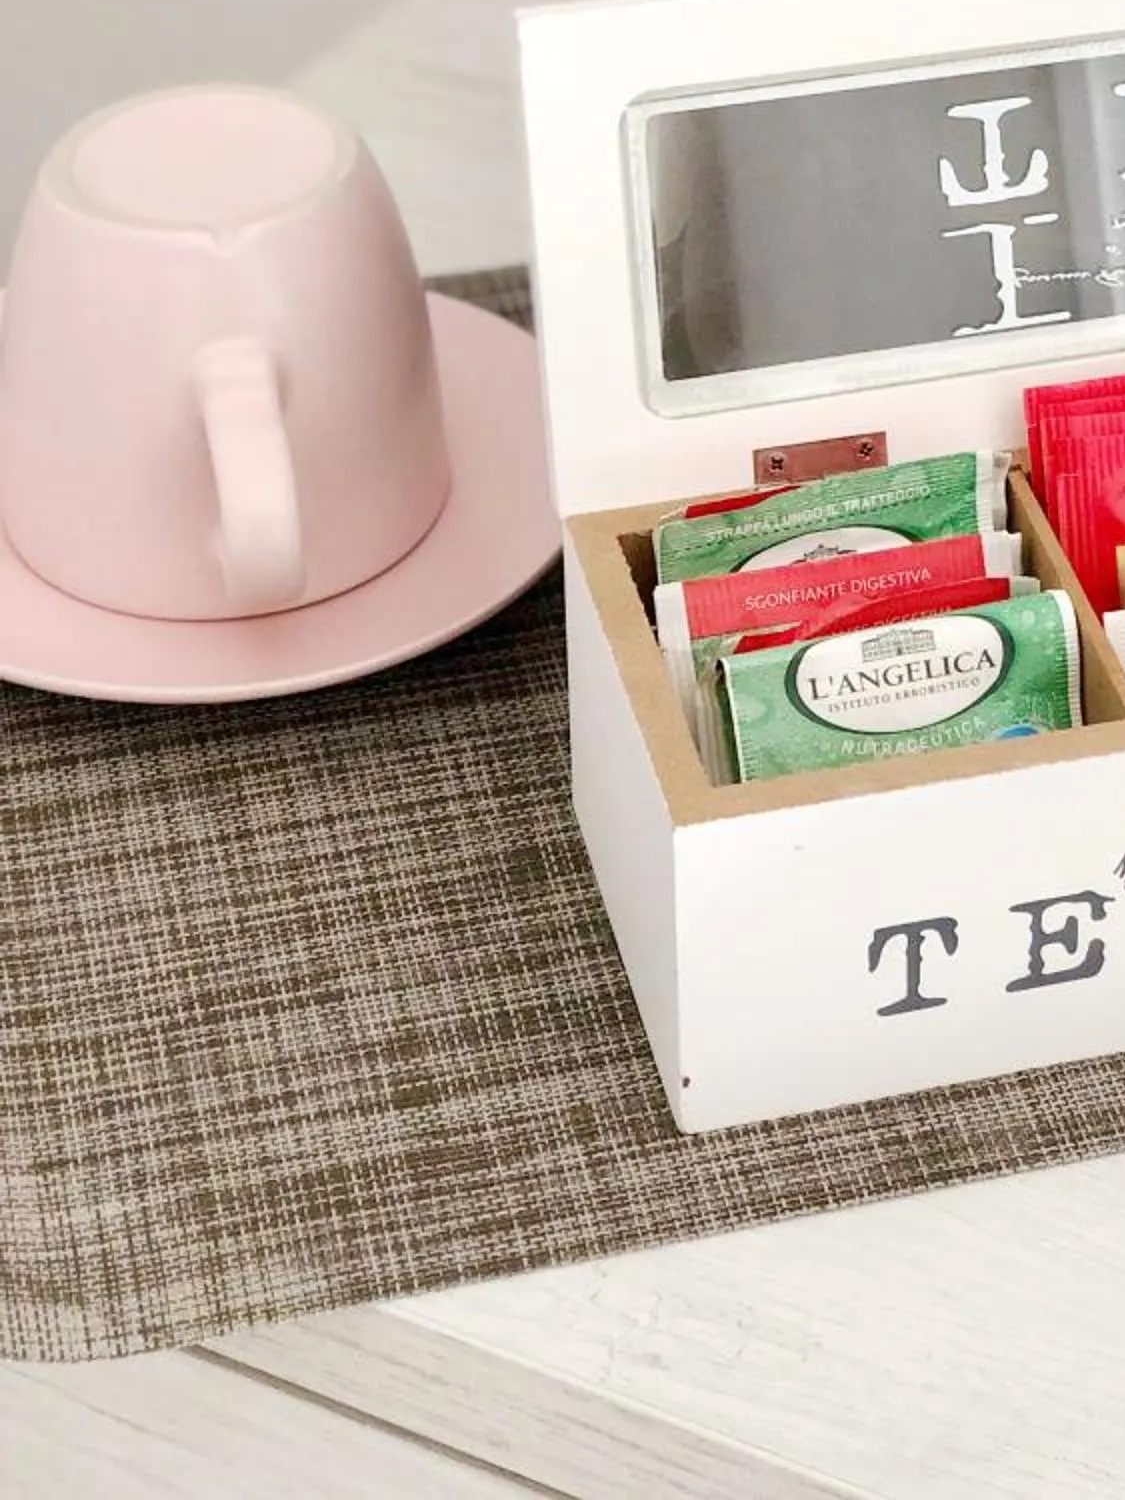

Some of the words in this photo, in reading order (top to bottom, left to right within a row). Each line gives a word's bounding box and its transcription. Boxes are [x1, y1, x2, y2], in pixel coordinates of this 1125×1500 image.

[745, 581, 849, 611] SGONFIANTE
[851, 567, 932, 594] DIGESTIVA
[807, 648, 996, 701] L'ANGELICA
[828, 693, 891, 713] ISTITUTO
[895, 676, 981, 699] ERBORISTICO
